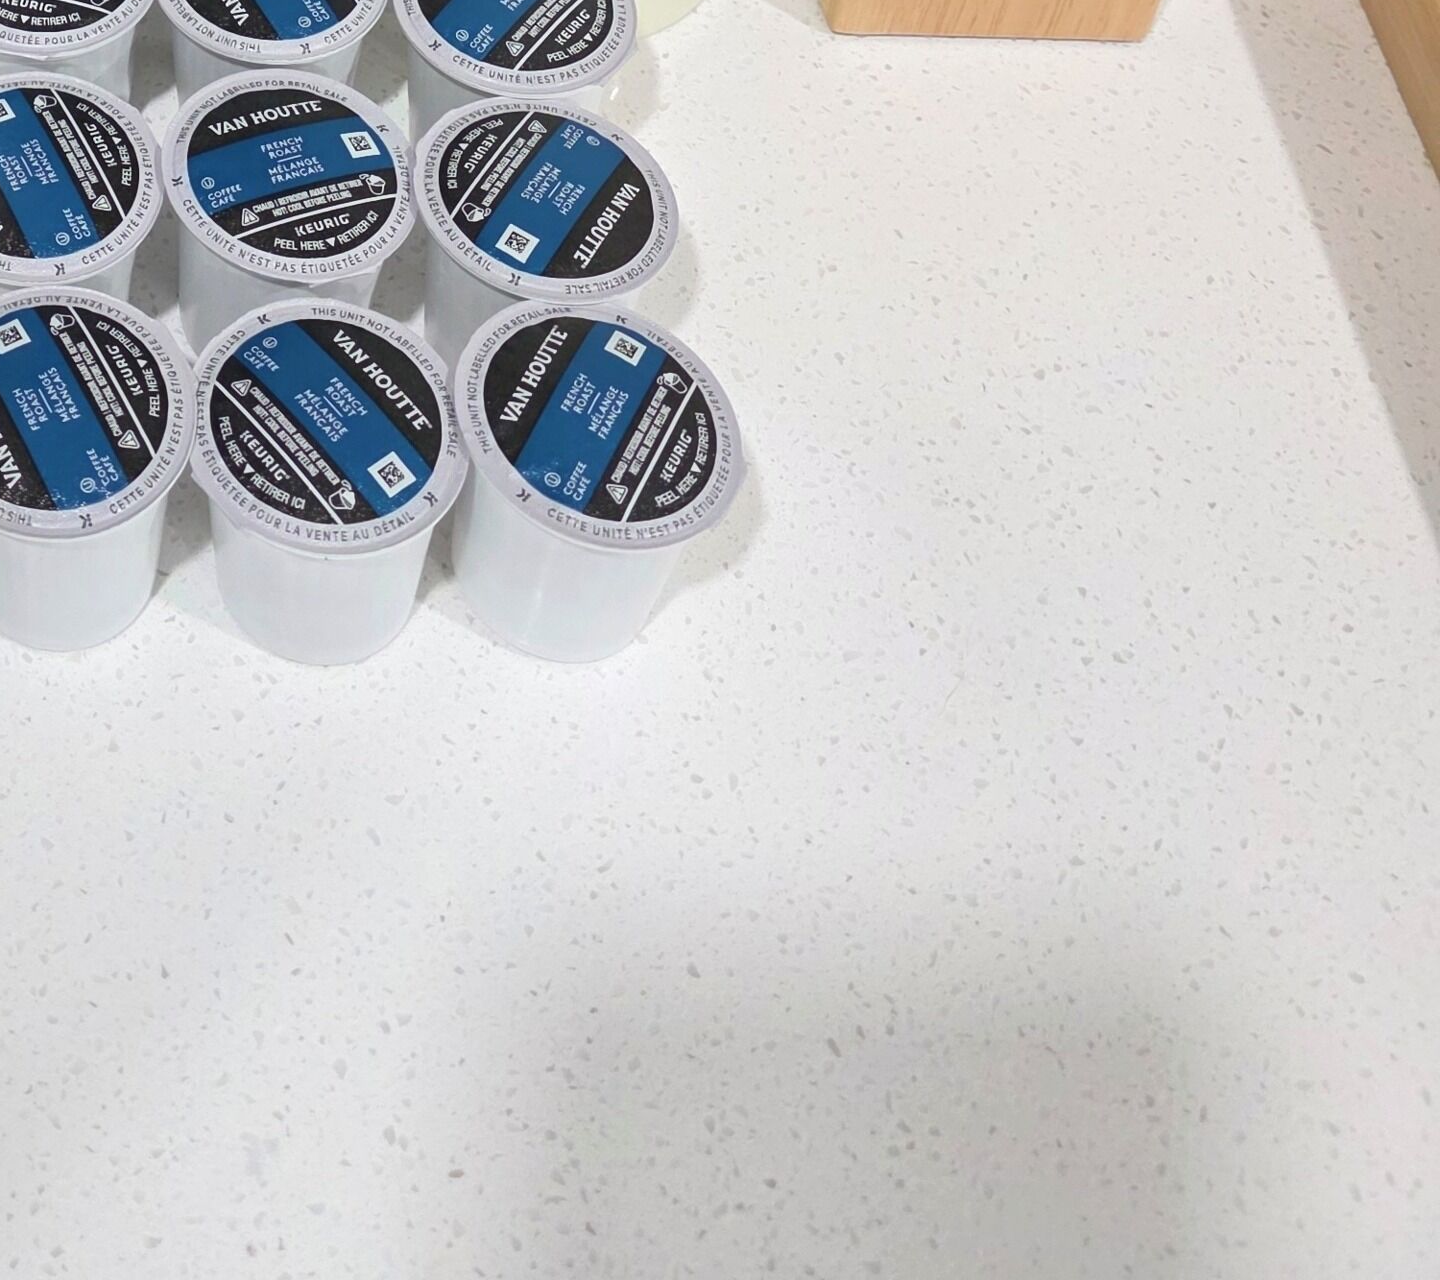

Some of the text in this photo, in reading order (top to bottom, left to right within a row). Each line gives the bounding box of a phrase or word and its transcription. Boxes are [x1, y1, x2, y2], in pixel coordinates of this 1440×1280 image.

[31, 16, 66, 26] RETIRER
[68, 13, 81, 24] ICI
[554, 10, 591, 47] KEURIG
[546, 50, 569, 63] PEEL
[566, 39, 590, 56] HERE
[207, 99, 324, 136] VAN HOUTTE
[461, 126, 485, 143] HERE
[481, 118, 505, 130] PEEL
[29, 138, 60, 183] FRANÇAIS
[74, 102, 132, 186] PEEL HERE RETIRER ICI
[85, 123, 119, 167] KEURIG
[259, 135, 304, 152] FRENCH
[268, 144, 304, 159] ROAST
[462, 133, 497, 171] KEURIG
[7, 154, 29, 185] ROAST
[21, 142, 50, 186] MÉLANGE
[267, 156, 320, 176] MÉLANGE
[270, 164, 326, 184] FRANÇAIS
[519, 161, 553, 200] FRANÇAIS
[206, 183, 244, 201] COFFEE
[211, 193, 236, 209] CAFÉ
[529, 167, 562, 204] MÉLANGE
[551, 181, 575, 207] ROAST
[558, 184, 586, 216] FRENCH
[62, 206, 84, 241] COFFEE
[74, 213, 92, 238] CAFÉ
[182, 195, 411, 274] CETTE UNITÉ N'EST PAS ÉTIQUETÉE POUR LA VENTE
[274, 209, 379, 251] PEEL HERE RETIRER ICI
[294, 214, 351, 238] KEURIG
[571, 182, 641, 266] VAN HOUTTE
[94, 320, 160, 417] PEEL HERE RETIRER ICI
[107, 344, 145, 396] KEURIG
[242, 351, 266, 370] CAFÉ
[250, 345, 280, 373] COFFEE
[498, 326, 570, 423] VAN HOUTTE
[38, 371, 71, 423] MÉLANGE
[46, 366, 82, 420] FRANÇAIS
[311, 307, 459, 457] THIS UNIT NOT LABELLED FOR RETAIL SALE
[329, 376, 369, 417] FRENCH
[331, 328, 431, 432] VAN HOUTTE
[559, 372, 589, 412] FRENCH
[572, 381, 597, 414] ROAST
[11, 387, 41, 432] FRENCH
[24, 387, 49, 423] ROAST
[293, 393, 342, 444] FRANÇAIS
[302, 388, 348, 436] MÉLANGE
[324, 385, 357, 418] ROAST
[587, 385, 620, 433] MÉLANGE
[597, 390, 630, 440] FRANÇAIS
[86, 446, 111, 486] COFFEE
[99, 454, 120, 482] CAFÉ
[218, 415, 308, 510] PEEL HERE RETIRER ICI
[238, 430, 288, 482] KEURIG
[654, 410, 708, 508] PEEL HERE RETIRER ICI
[660, 431, 694, 484] KEURIG
[195, 422, 418, 543] PAS ÉTIQUETÉE POUR LA VENTE AU DÉTAIL
[561, 460, 589, 496] COFFEE
[572, 475, 592, 502] CAFÉ
